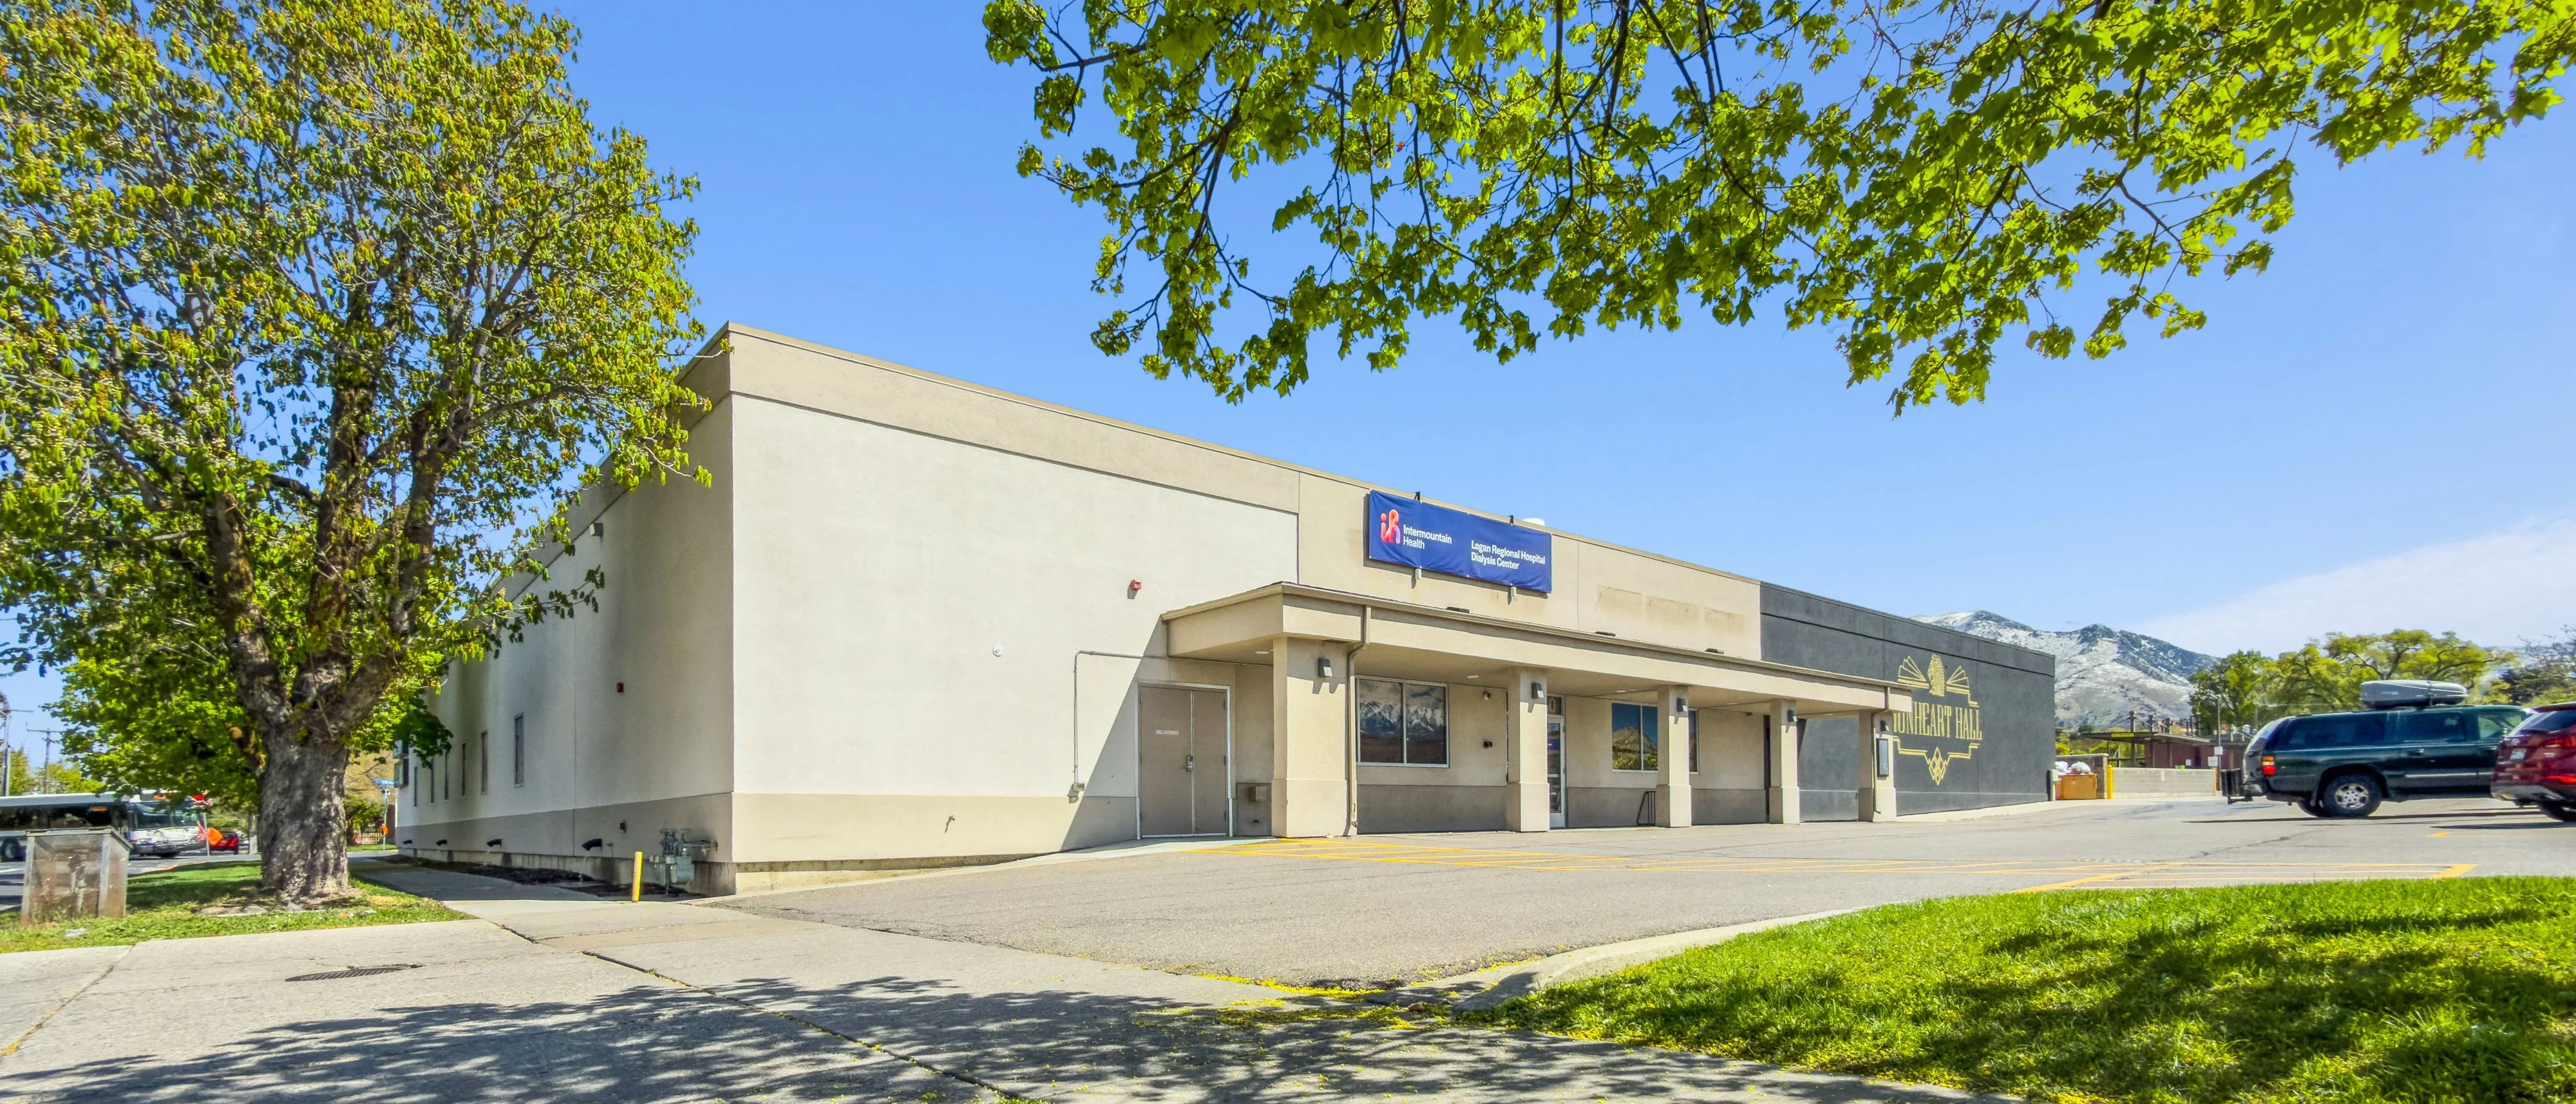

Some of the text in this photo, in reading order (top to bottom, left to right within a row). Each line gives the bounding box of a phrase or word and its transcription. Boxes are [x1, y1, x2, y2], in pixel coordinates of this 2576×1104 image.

[1403, 524, 1452, 544] Intermountain
[1403, 536, 1425, 549] Health
[1471, 540, 1546, 564] Logan Regional Hospital
[1471, 551, 1520, 570] Dialysis Center
[1893, 701, 1983, 740] IONHEART HALL
